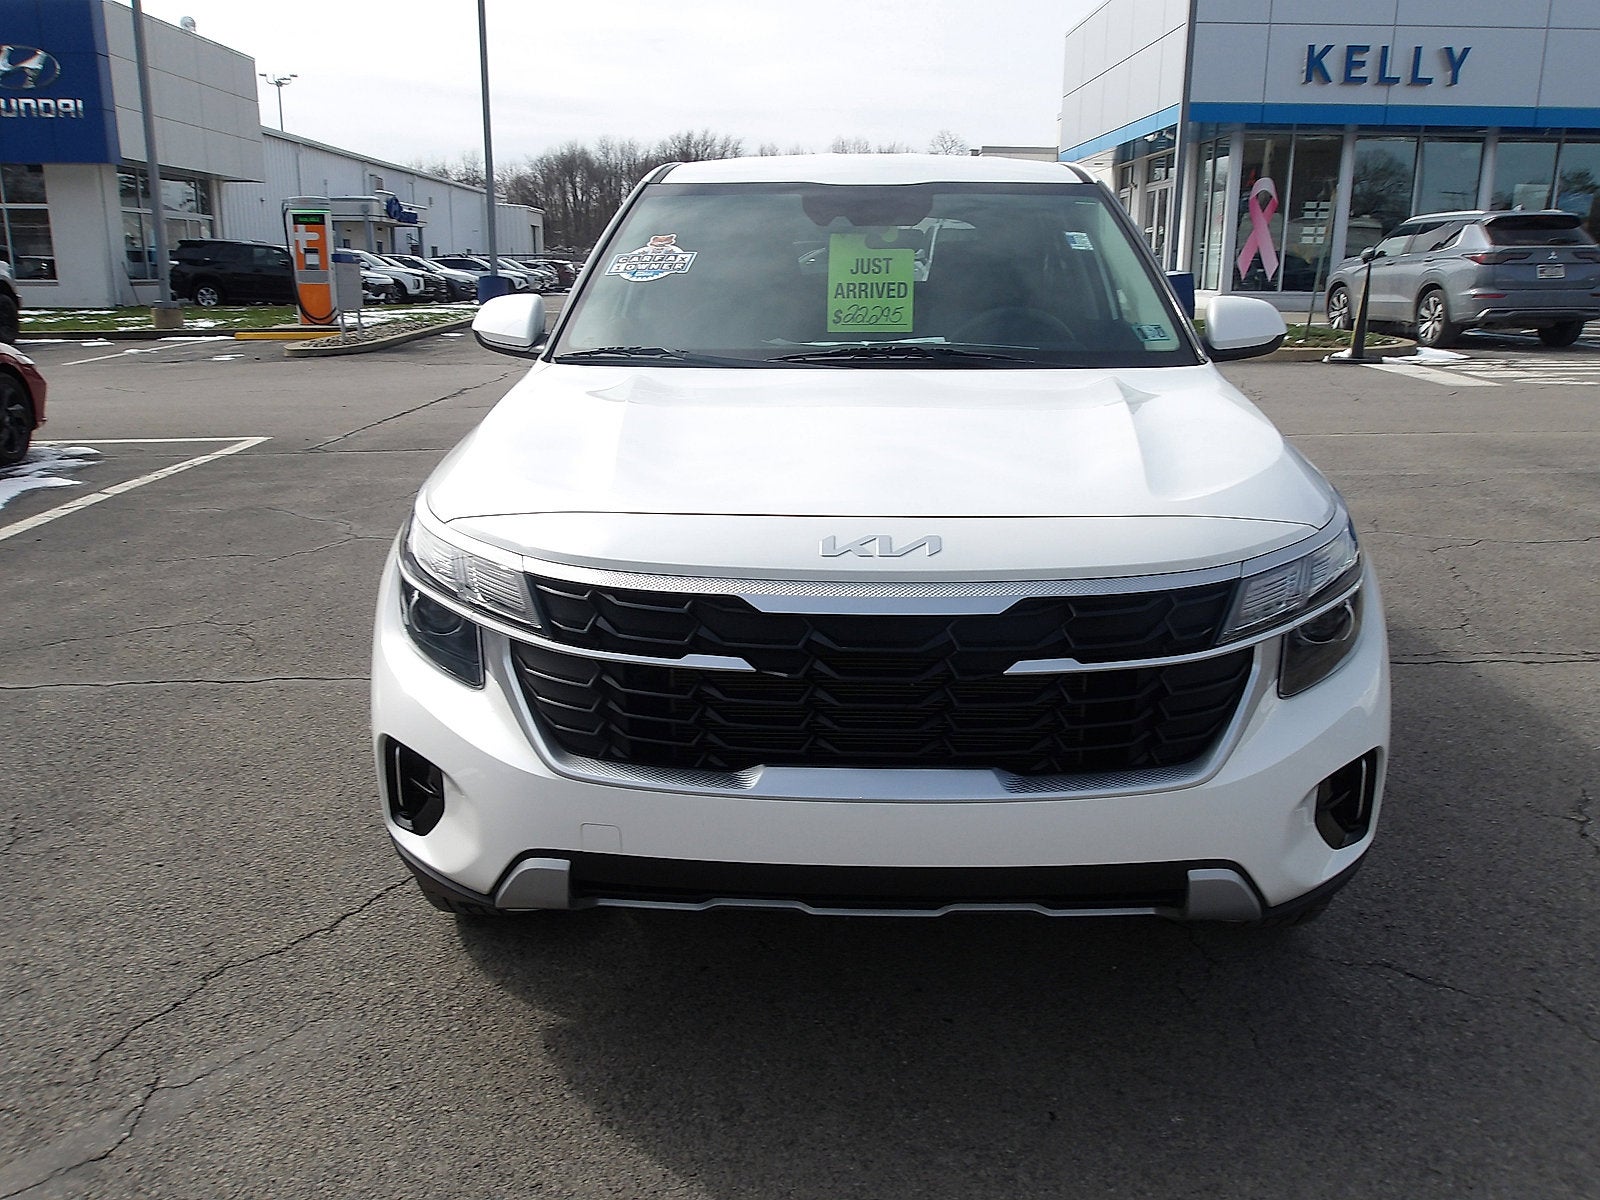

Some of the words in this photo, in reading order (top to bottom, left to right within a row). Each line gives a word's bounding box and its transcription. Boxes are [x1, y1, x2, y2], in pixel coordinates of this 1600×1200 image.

[1303, 44, 1472, 86] KELLY
[618, 254, 689, 263] CARFAX
[625, 263, 685, 271] OWNER
[850, 258, 893, 275] JUST
[833, 282, 908, 299] ARRIVED
[819, 535, 942, 557] KIA
